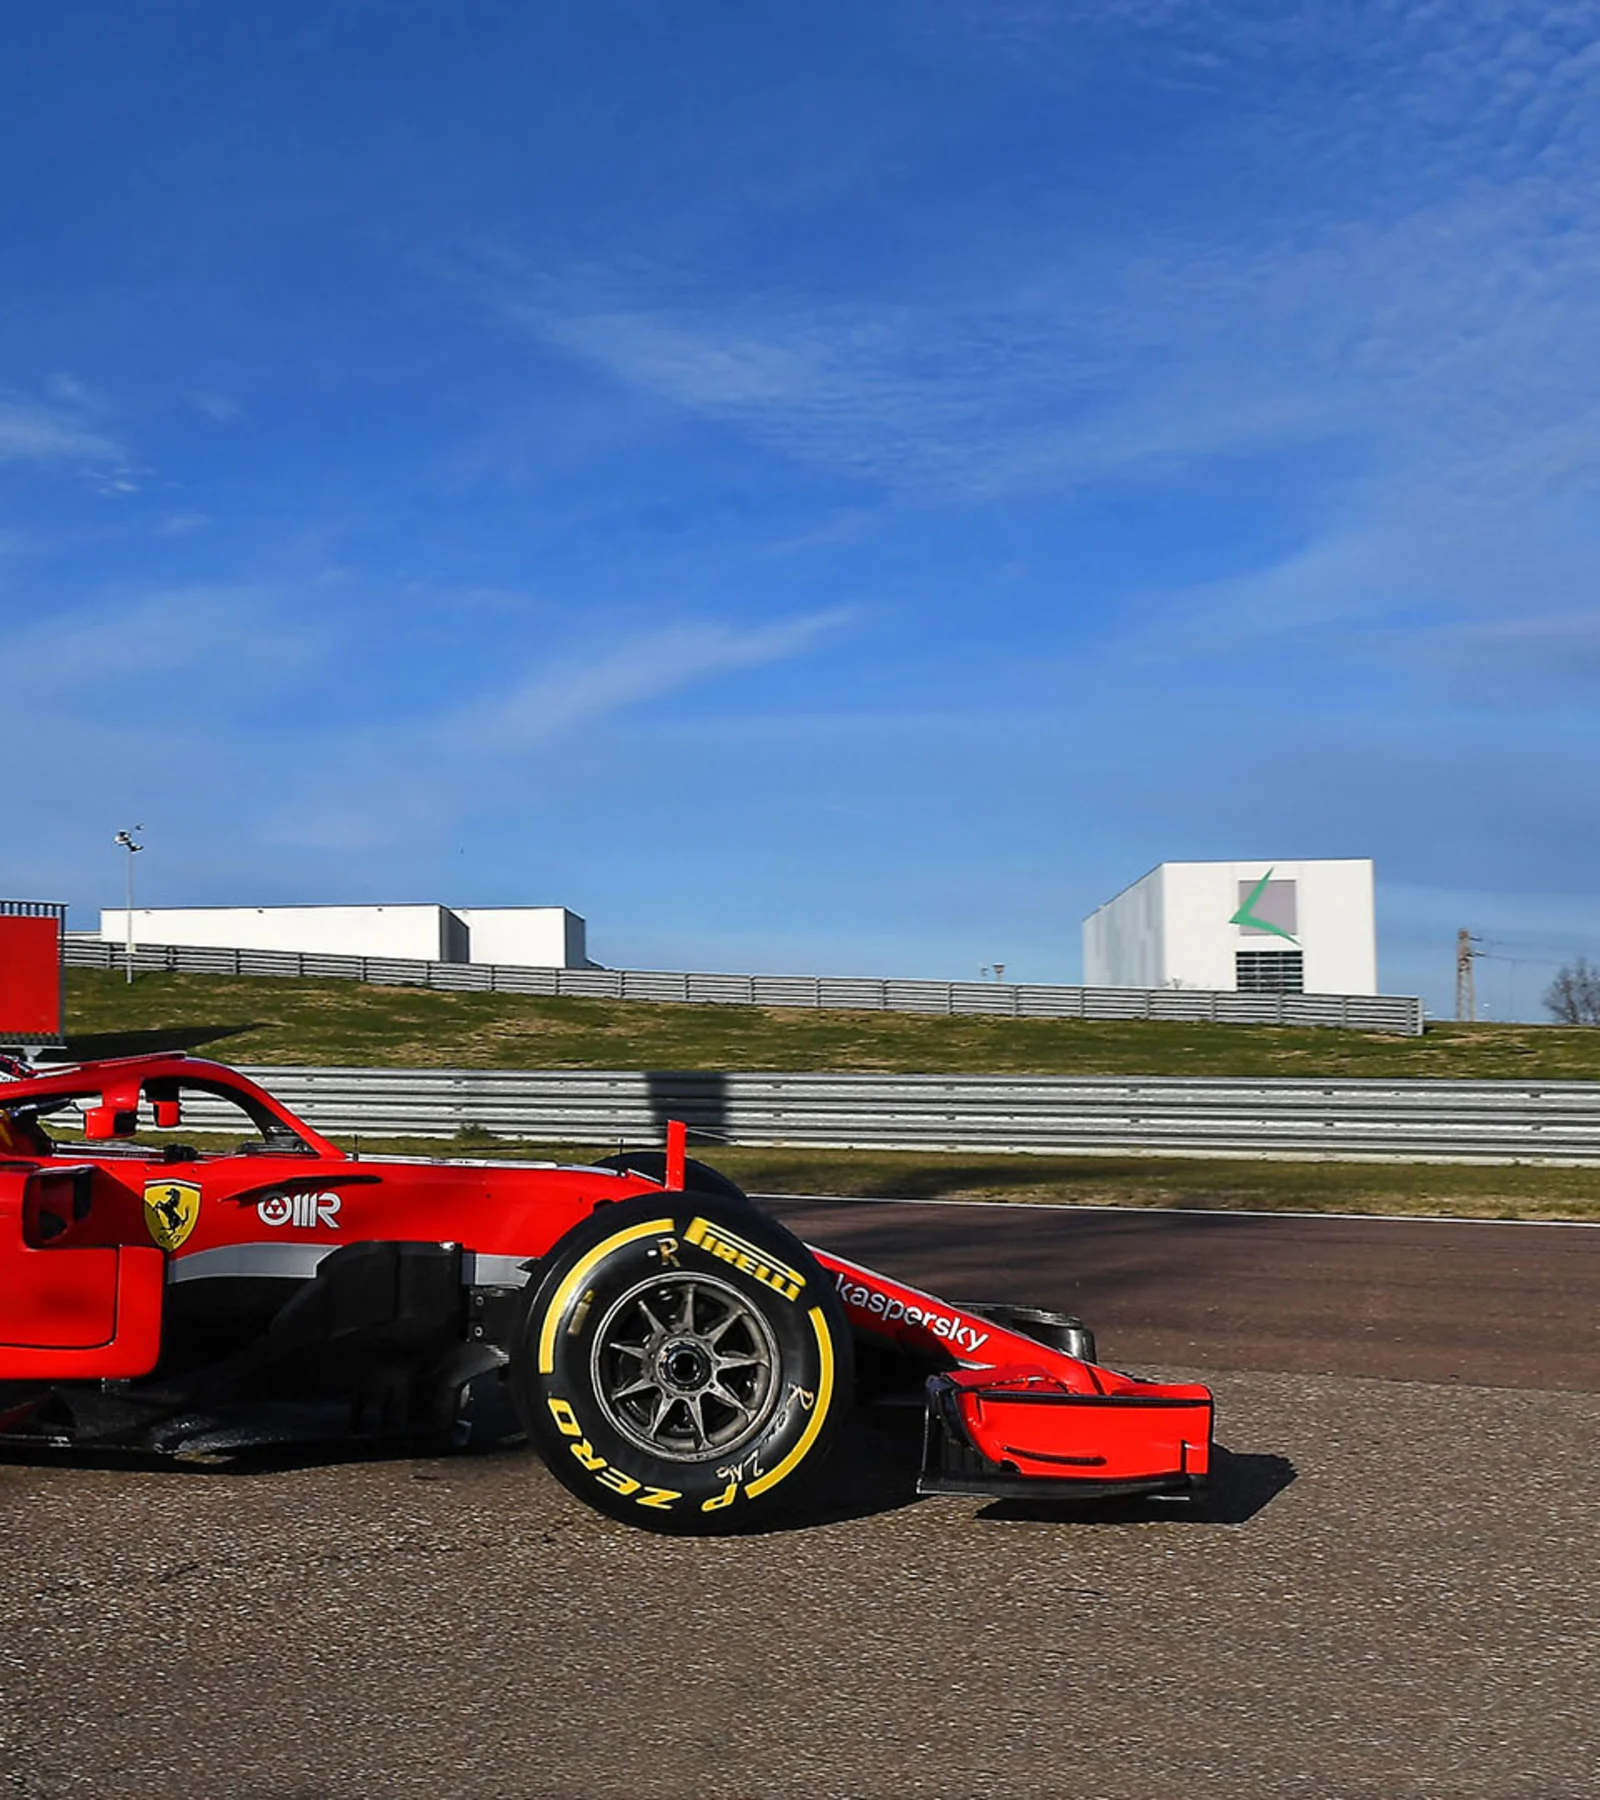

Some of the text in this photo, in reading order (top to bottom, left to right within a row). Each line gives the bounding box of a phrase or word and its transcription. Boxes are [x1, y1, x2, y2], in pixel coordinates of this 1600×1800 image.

[683, 1217, 806, 1302] PIRELLI
[835, 1272, 989, 1353] kaspersky
[548, 1398, 683, 1510] ZERO
